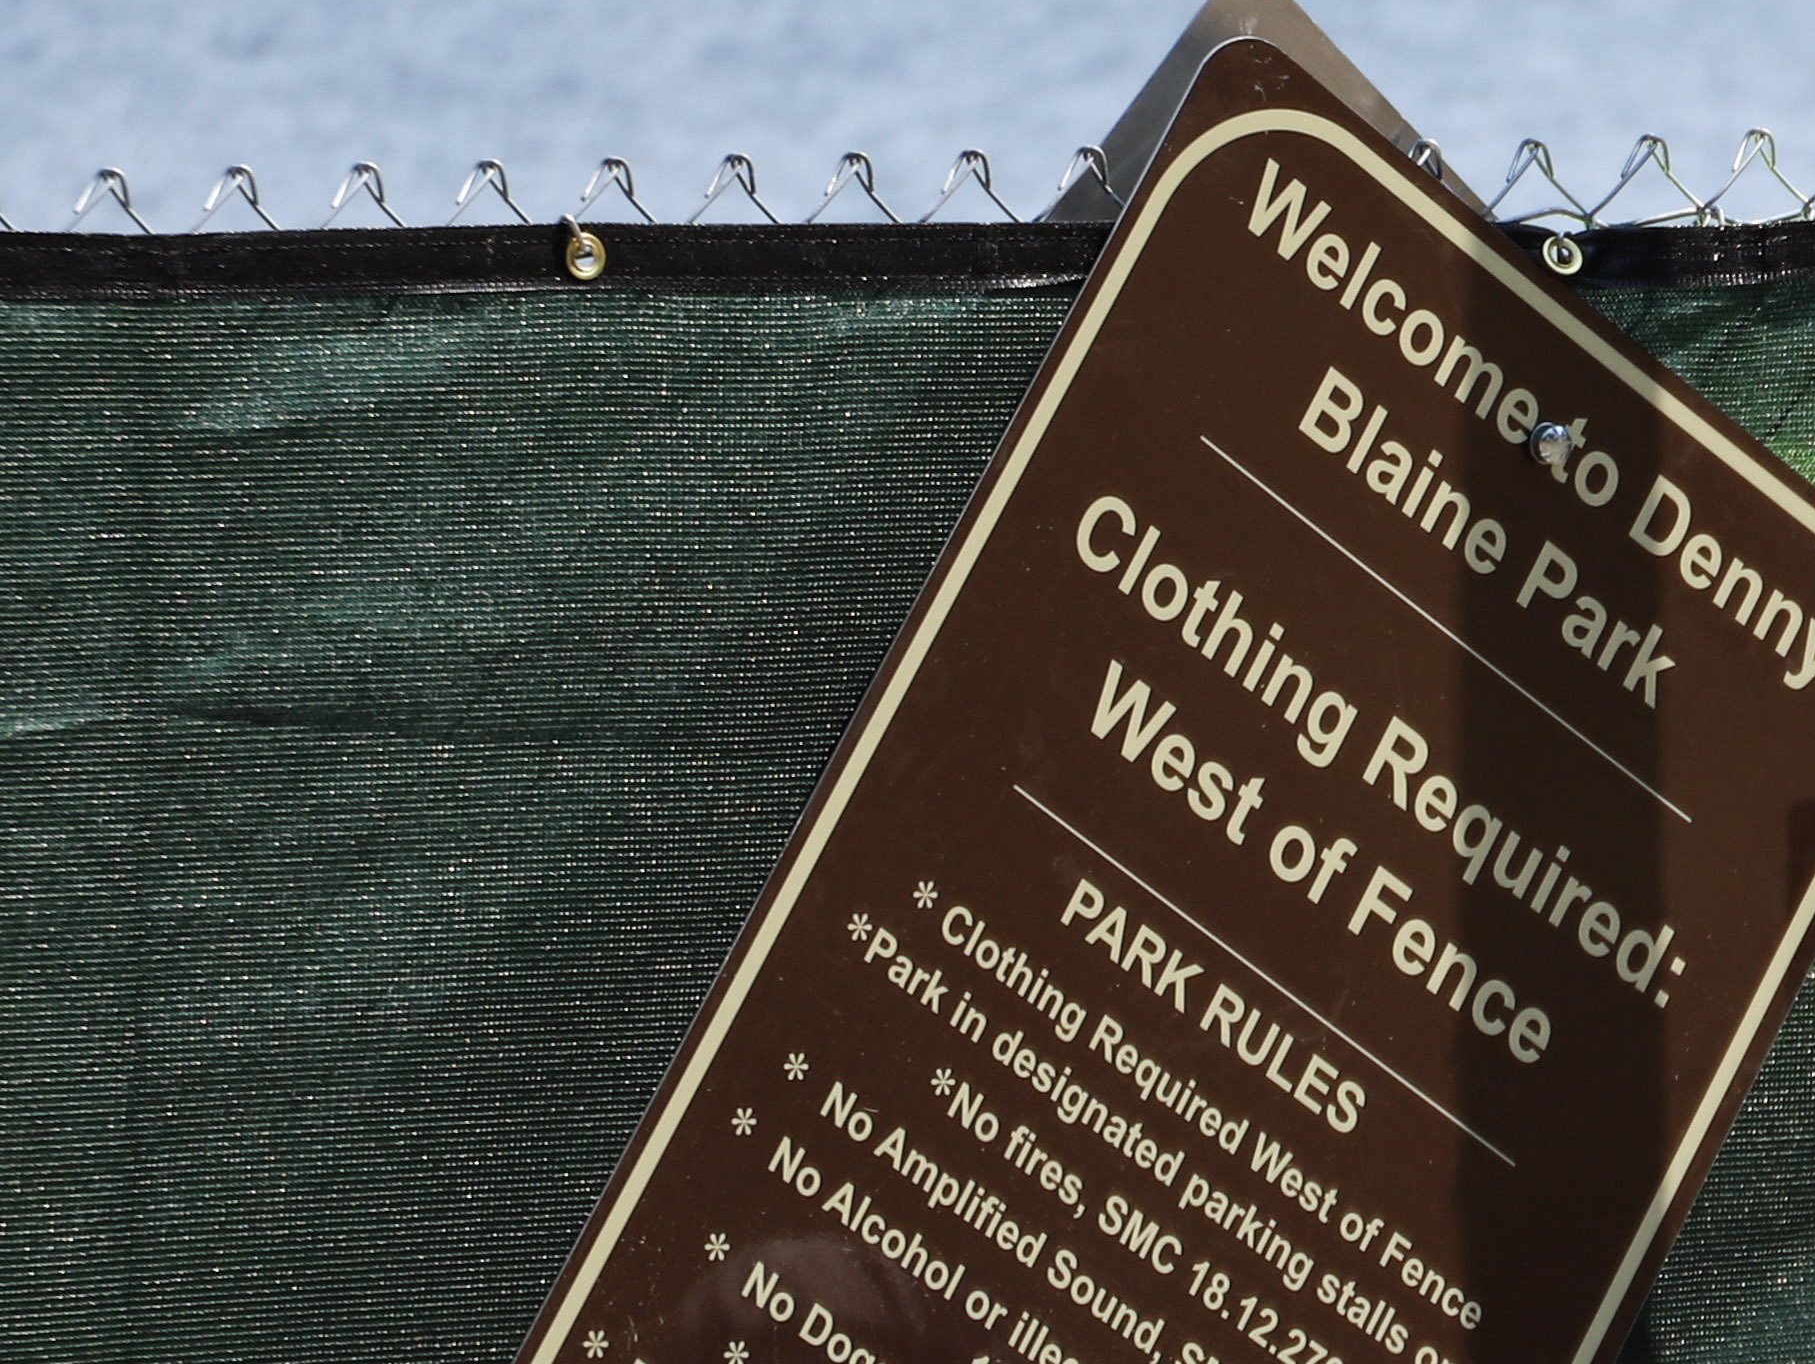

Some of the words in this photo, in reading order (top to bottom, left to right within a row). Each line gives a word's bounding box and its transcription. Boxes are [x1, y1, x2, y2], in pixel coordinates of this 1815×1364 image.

[1248, 158, 1538, 443] Welcome
[1298, 366, 1506, 573] Blaine
[1517, 541, 1676, 708] Park
[1077, 496, 1358, 767] Clothing
[1362, 716, 1686, 1008] Required:
[1091, 659, 1265, 845] West
[1269, 825, 1357, 904] of
[1348, 865, 1550, 1062] Fence
[942, 906, 1086, 1042] Clothing
[1089, 1014, 1249, 1155] Required
[1251, 1131, 1338, 1223] West
[1340, 1212, 1384, 1252] of
[1379, 1231, 1481, 1329] Fence
[1061, 878, 1204, 1013] PARK
[1200, 983, 1365, 1133] RULES
[741, 1261, 794, 1321] No
[768, 1136, 821, 1196] No
[822, 1182, 965, 1300] Alcohol
[966, 1290, 1008, 1330] or
[820, 1081, 872, 1141] No
[873, 1127, 1047, 1268] Amplified
[950, 991, 986, 1043] in
[992, 1030, 1185, 1186] designated
[1178, 1173, 1314, 1291] parking
[1317, 1274, 1408, 1354] stalls
[1004, 1125, 1085, 1219] fires,
[1098, 1195, 1182, 1274] SMC
